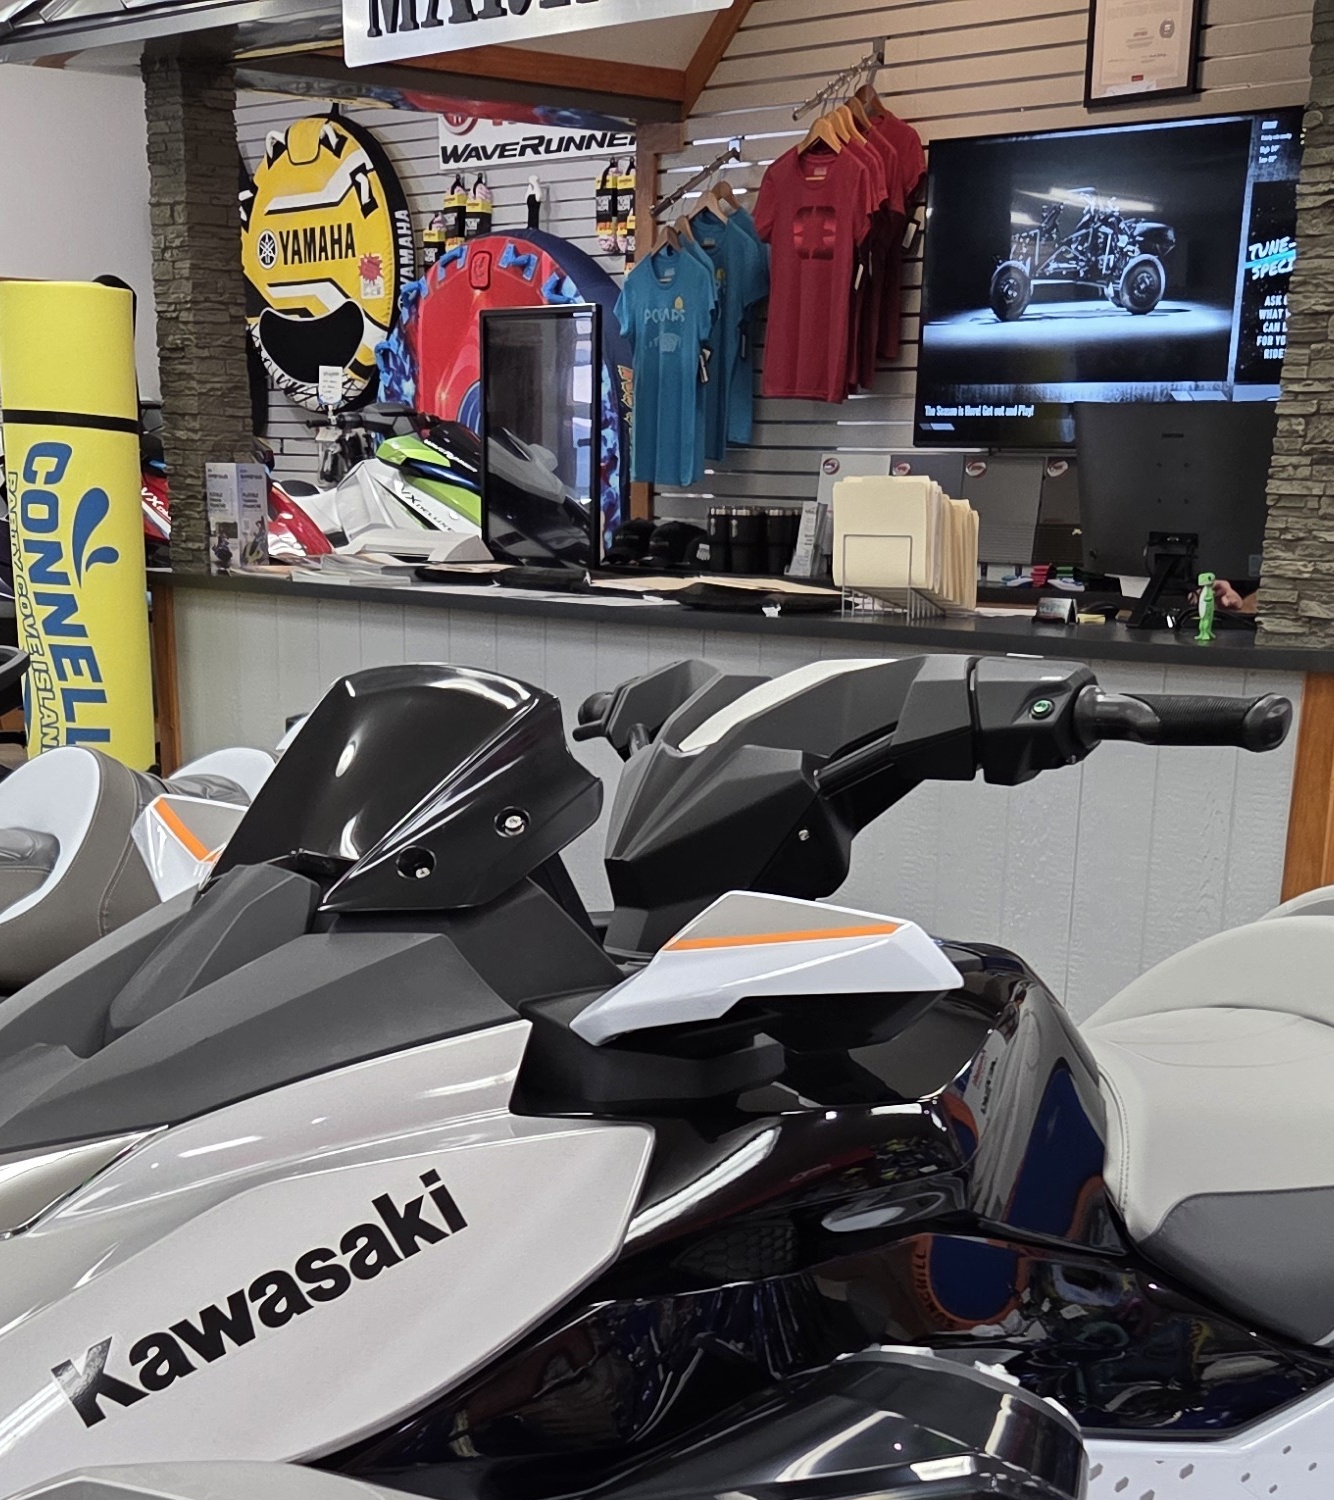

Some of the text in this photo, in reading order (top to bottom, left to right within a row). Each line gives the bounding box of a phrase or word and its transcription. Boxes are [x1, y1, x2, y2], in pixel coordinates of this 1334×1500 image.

[279, 222, 356, 266] YAMAHA
[1251, 257, 1295, 280] SPECI
[1259, 309, 1283, 320] WHAT
[22, 441, 111, 746] CONNELL
[30, 660, 60, 755] ISLAN
[51, 1168, 469, 1429] Kawasaki
